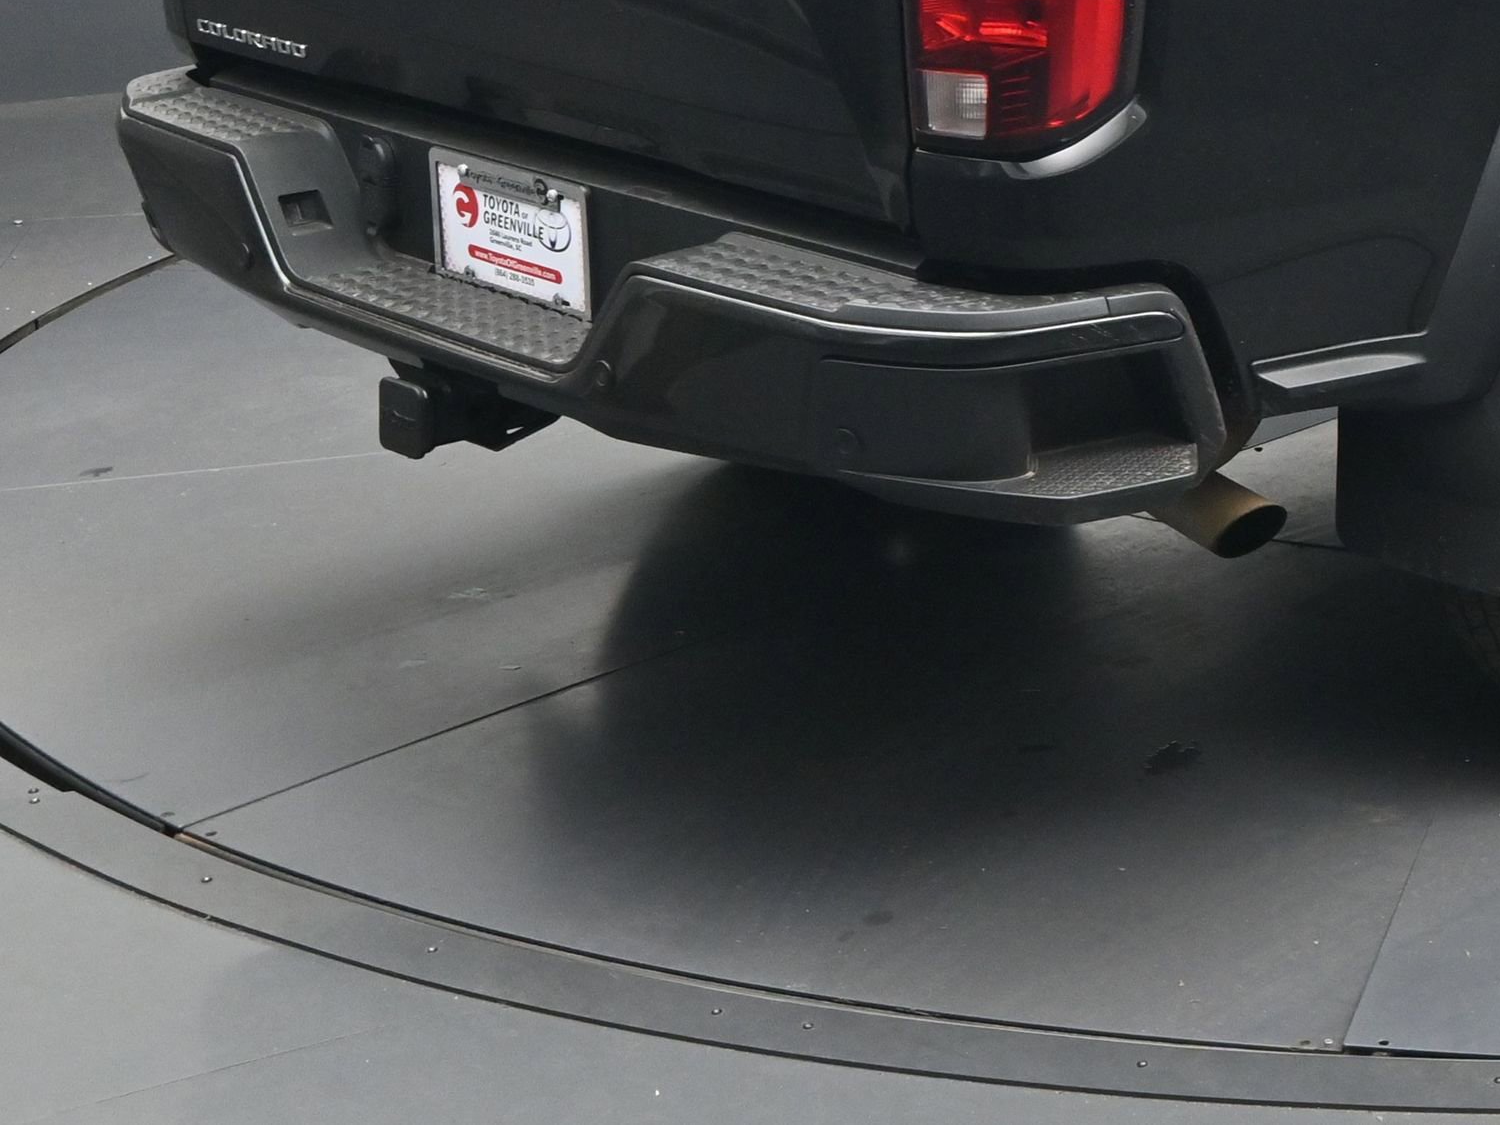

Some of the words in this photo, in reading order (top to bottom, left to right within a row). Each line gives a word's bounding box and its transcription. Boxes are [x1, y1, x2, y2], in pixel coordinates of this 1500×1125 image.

[197, 18, 308, 58] COLORADO
[483, 194, 520, 218] TOYOTA
[483, 210, 544, 241] GREENVILLE
